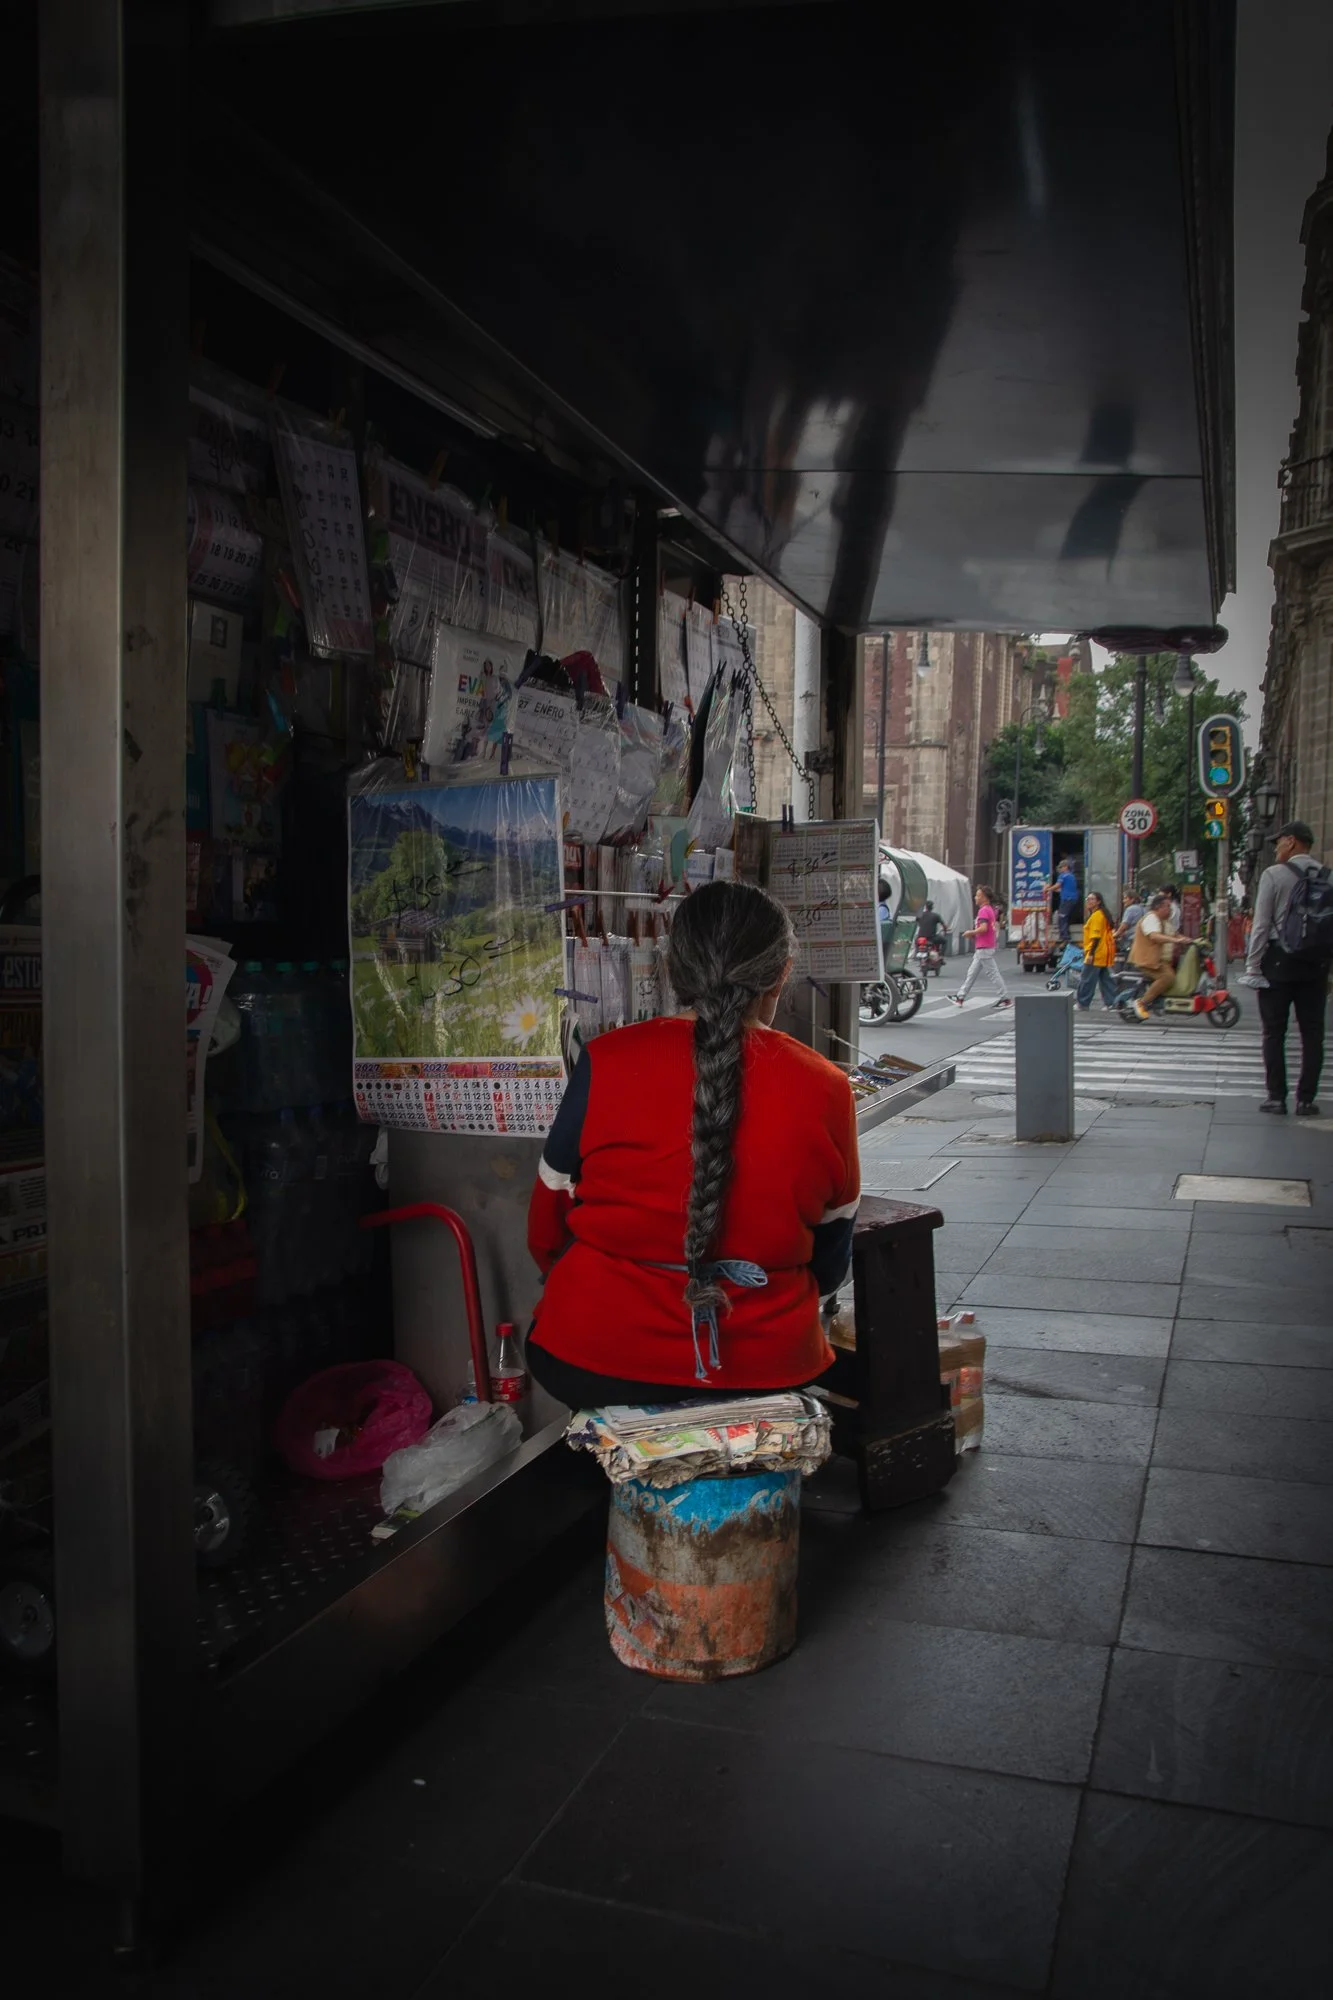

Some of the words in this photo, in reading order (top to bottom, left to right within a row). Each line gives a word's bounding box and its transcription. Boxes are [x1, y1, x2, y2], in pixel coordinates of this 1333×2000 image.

[210, 543, 222, 557] 18
[223, 545, 235, 560] 19
[457, 673, 485, 697] EVA
[533, 701, 565, 719] ENERO
[1124, 809, 1151, 817] ZONA
[1127, 818, 1148, 830] 30
[355, 1064, 380, 1072] 2027
[423, 1064, 449, 1072] 2027
[491, 1063, 518, 1071] 2027
